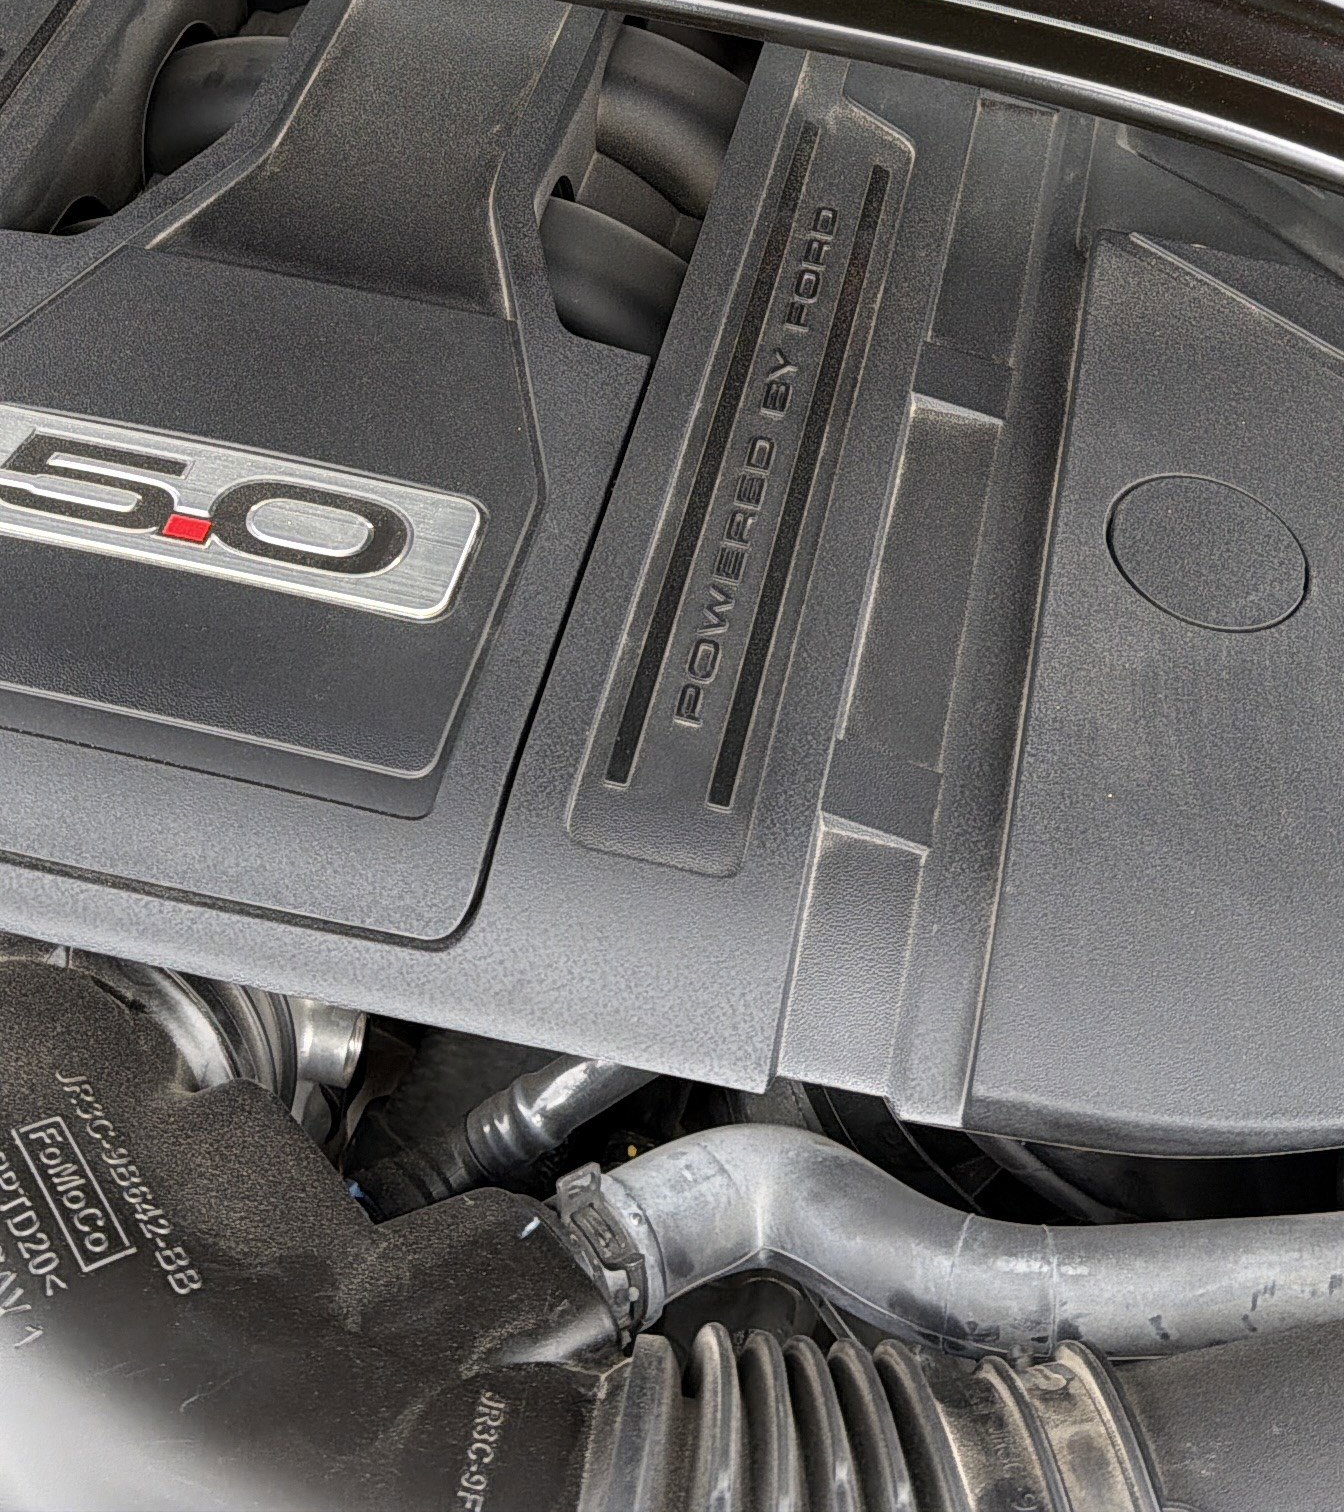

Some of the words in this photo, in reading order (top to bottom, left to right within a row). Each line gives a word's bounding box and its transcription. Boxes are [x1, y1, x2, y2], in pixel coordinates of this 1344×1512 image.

[673, 434, 777, 728] POWERED
[759, 347, 799, 420] BY
[783, 205, 839, 333] FORD
[29, 1127, 109, 1254] FoMoCo
[14, 1325, 45, 1350] 1
